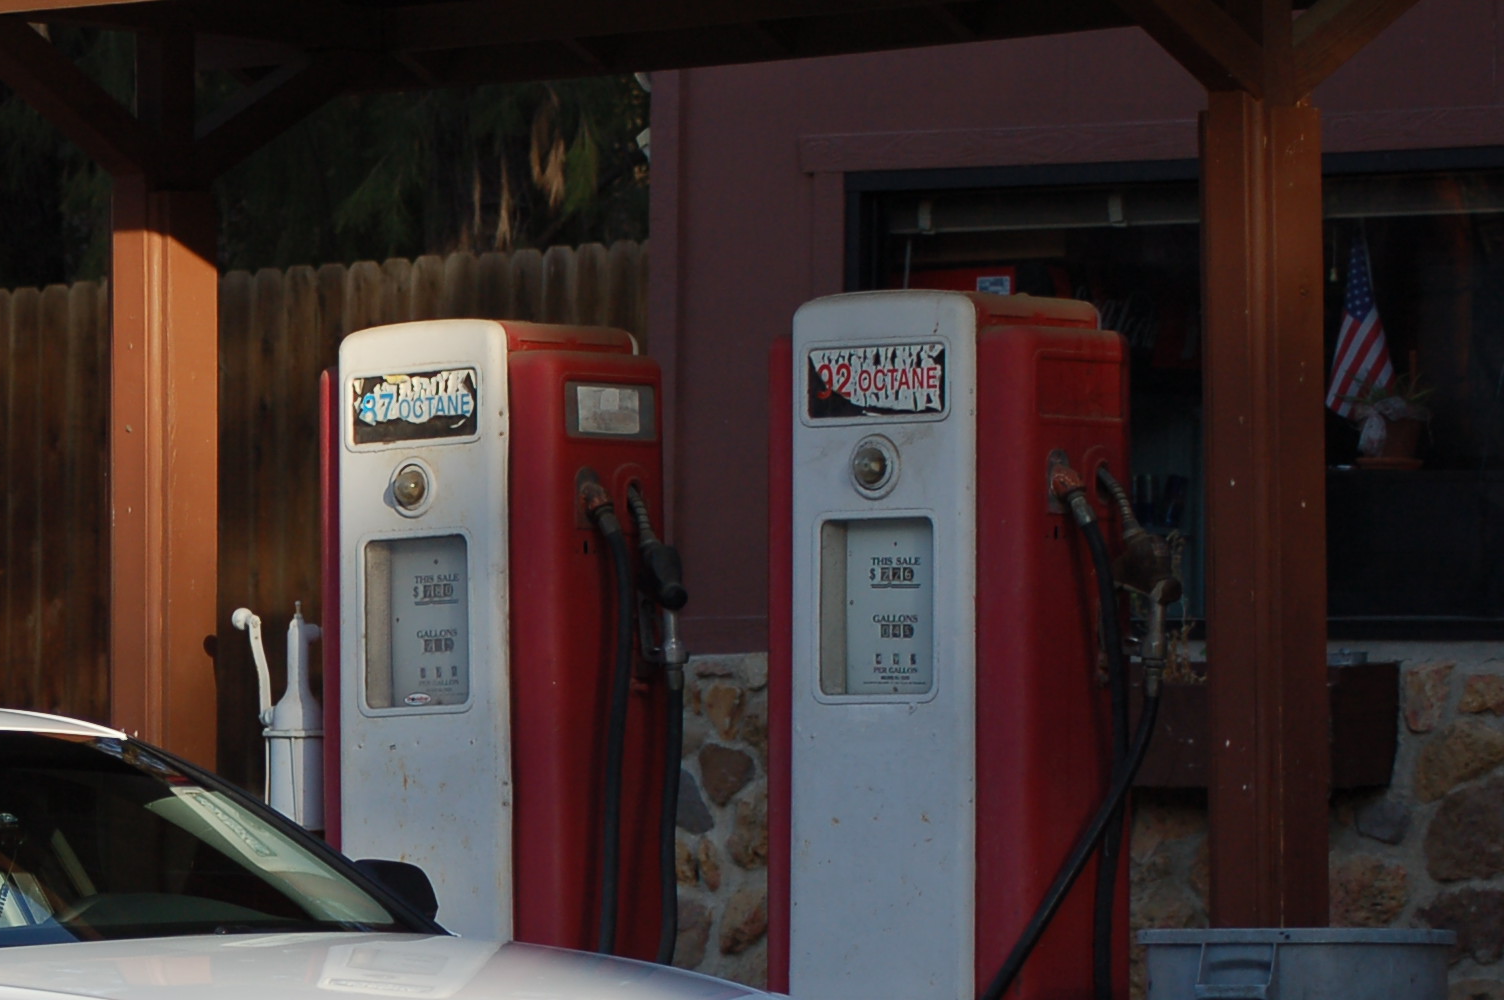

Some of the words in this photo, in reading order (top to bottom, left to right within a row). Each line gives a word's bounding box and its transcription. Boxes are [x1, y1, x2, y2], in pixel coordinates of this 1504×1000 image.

[817, 363, 853, 399] 92
[858, 367, 938, 392] OCTANE
[362, 393, 394, 421] 87
[399, 393, 471, 419] OCTANE
[870, 557, 893, 566] THIS
[896, 557, 921, 566] SALE
[415, 575, 435, 584] THIS
[437, 573, 460, 583] SALE
[872, 614, 919, 623] GALLONS
[416, 629, 458, 639] GALLONS
